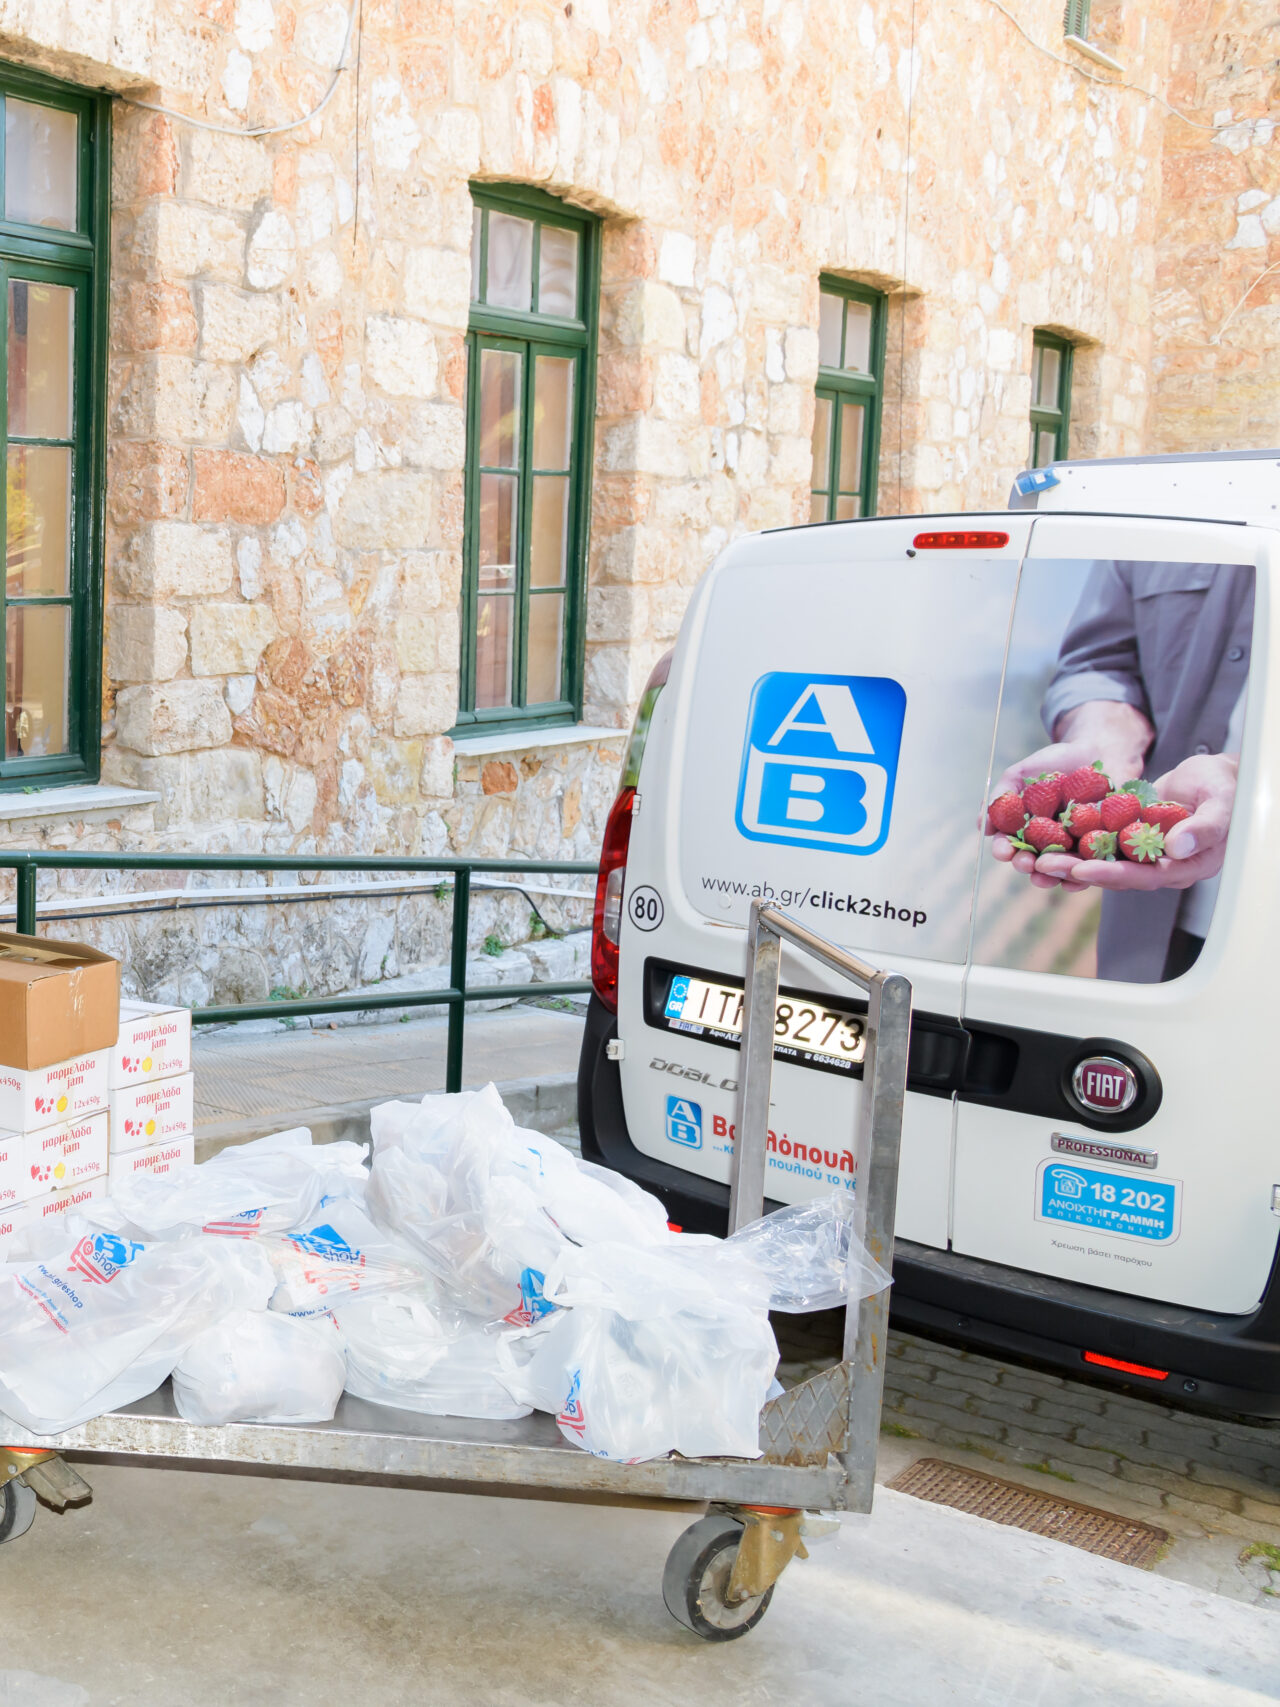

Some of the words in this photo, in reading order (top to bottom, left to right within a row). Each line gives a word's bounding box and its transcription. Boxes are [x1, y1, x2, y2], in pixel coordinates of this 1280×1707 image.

[634, 896, 659, 922] 80
[702, 876, 927, 928] www.ab.gr/click2shop
[668, 1001, 683, 1012] GR
[133, 1024, 177, 1043] μαρμελάδα
[775, 1003, 865, 1052] 8273
[151, 1039, 166, 1051] jam
[47, 1059, 96, 1083] μαρμελάδα
[67, 1076, 84, 1089] jam
[1087, 1071, 1124, 1100] FIAT
[136, 1087, 181, 1107] μαρμελάδα
[154, 1101, 170, 1114] jam
[42, 1125, 92, 1151] μαρμελάδα
[63, 1142, 80, 1157] jam
[134, 1149, 181, 1171] μαρμελάδα
[1057, 1139, 1149, 1165] PROFESSIONAL
[827, 1173, 840, 1185] το
[1090, 1183, 1116, 1203] 18
[1120, 1188, 1165, 1213] 202
